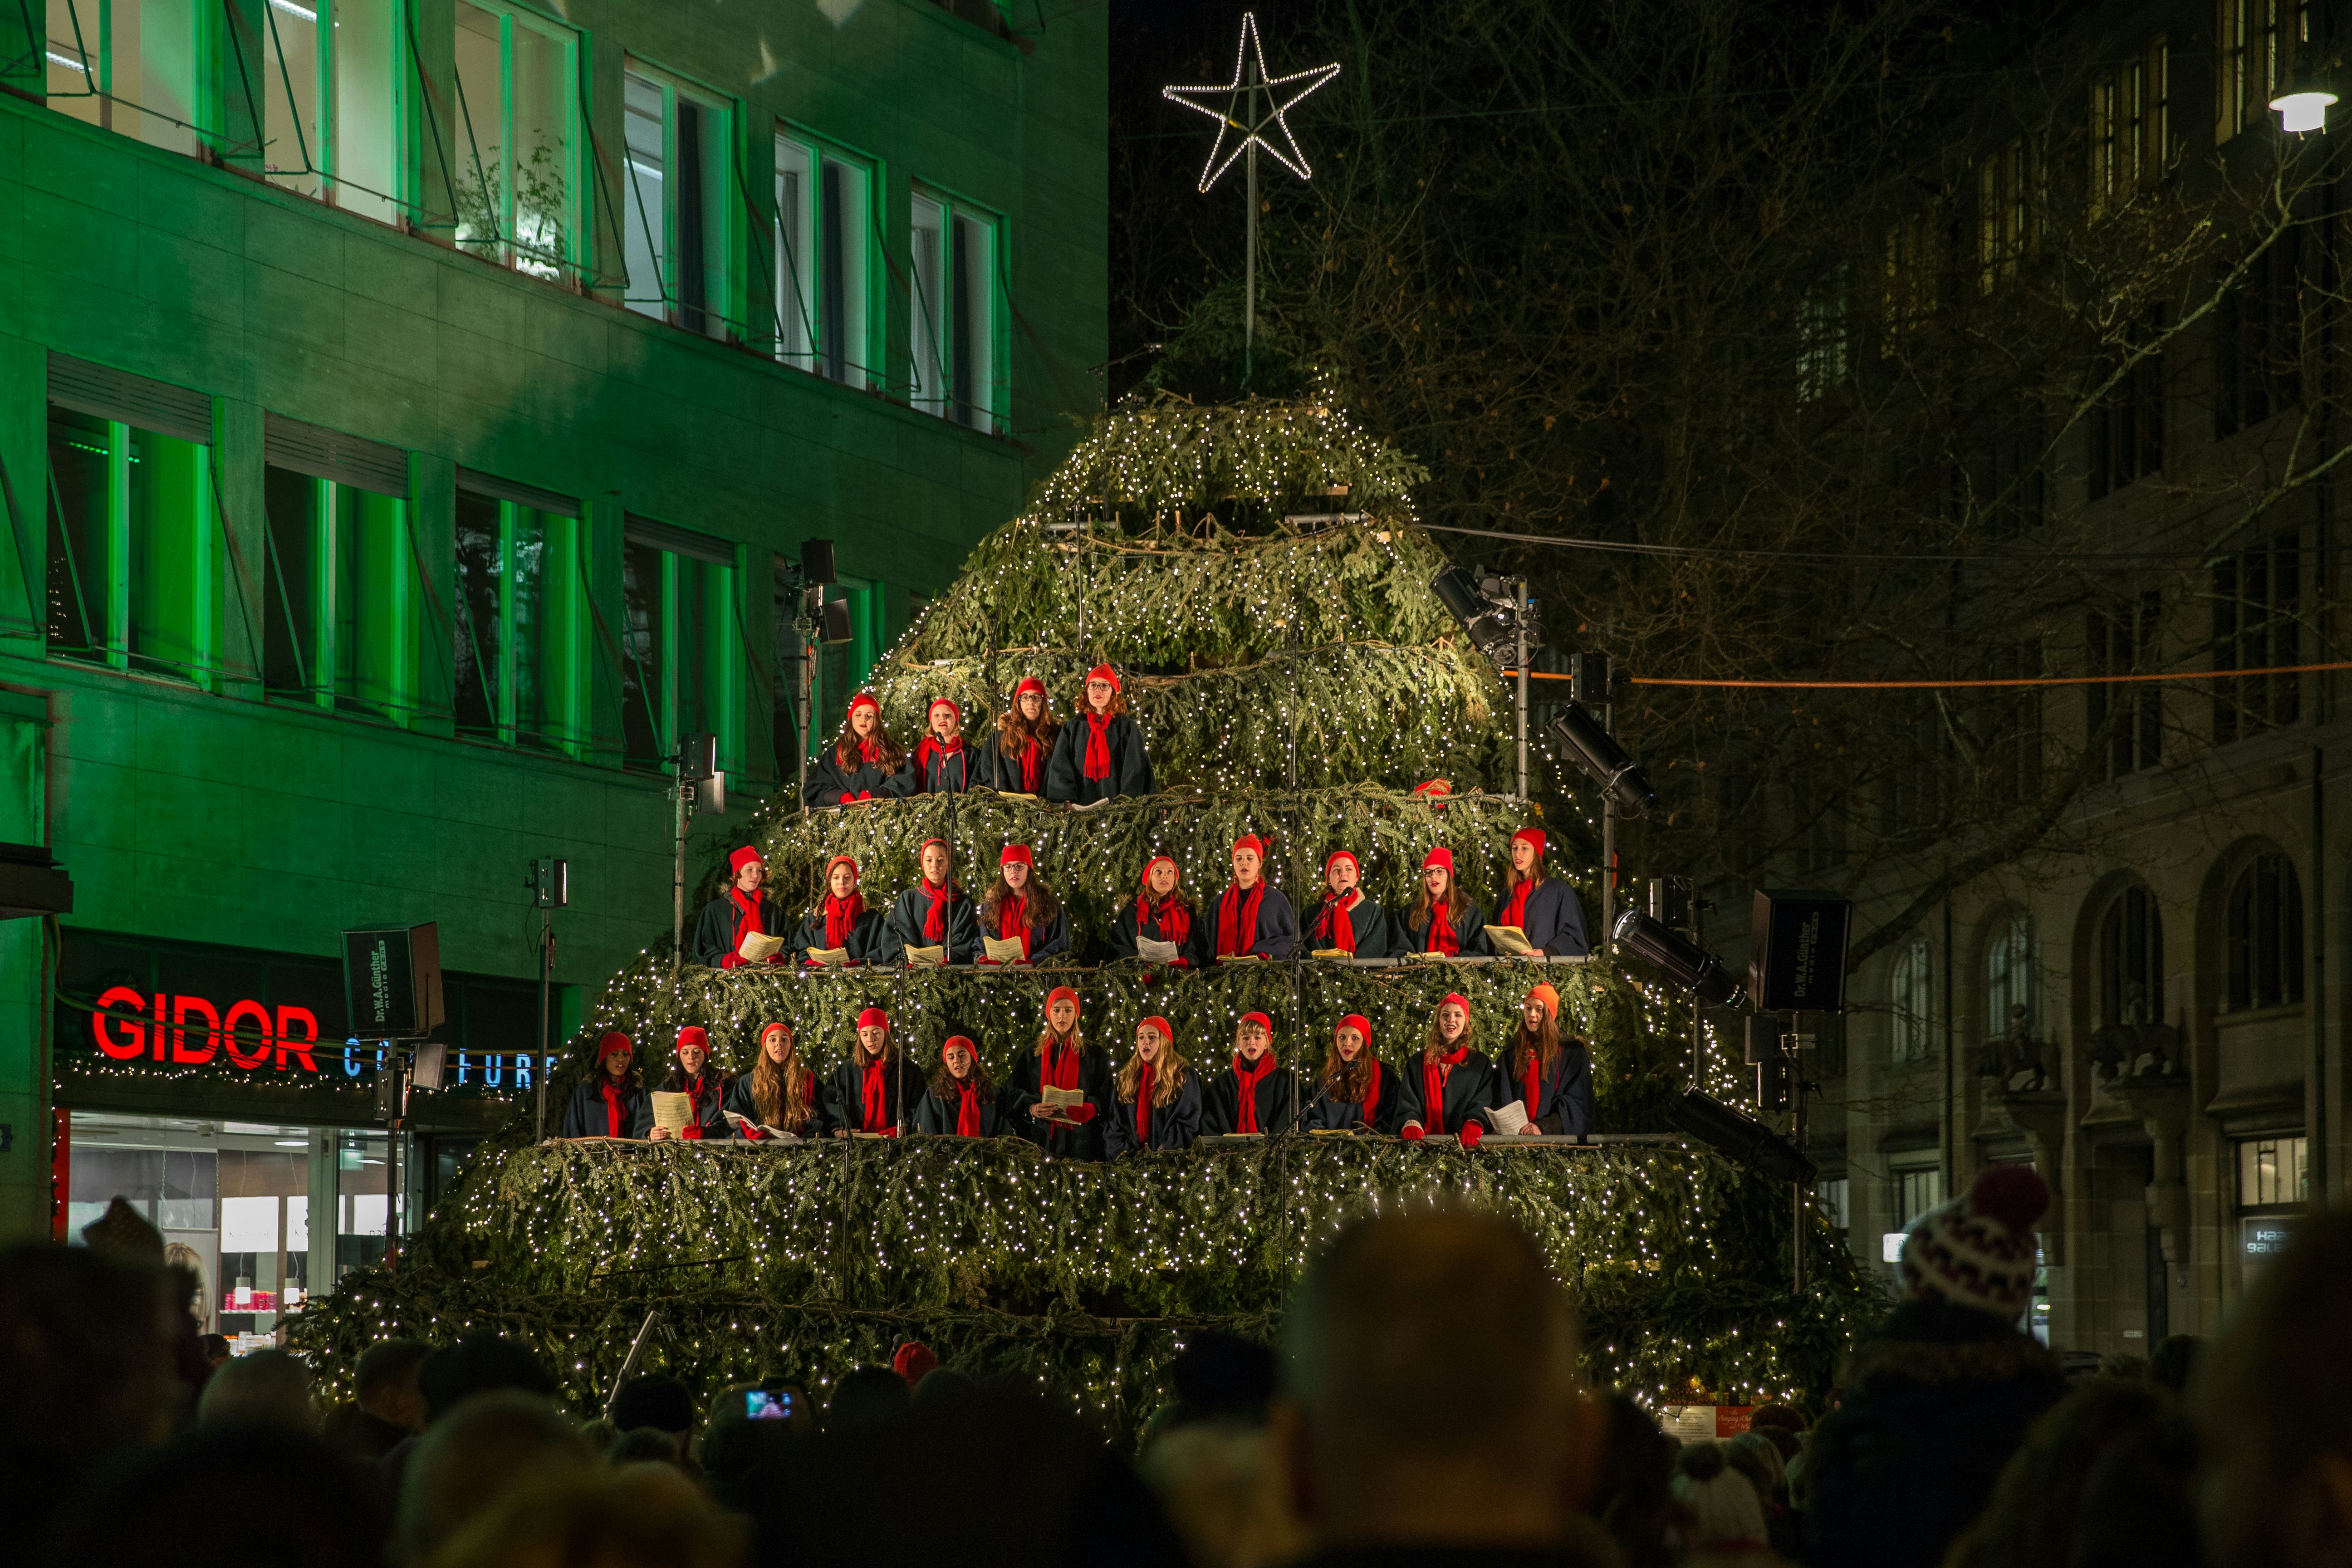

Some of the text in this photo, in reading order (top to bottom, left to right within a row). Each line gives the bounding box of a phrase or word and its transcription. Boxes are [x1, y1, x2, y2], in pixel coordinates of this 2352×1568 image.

[371, 951, 385, 1022] Dr.W.A.Günther
[1794, 922, 1811, 997] Dr.W.A.Günther
[93, 986, 318, 1072] GIDOR
